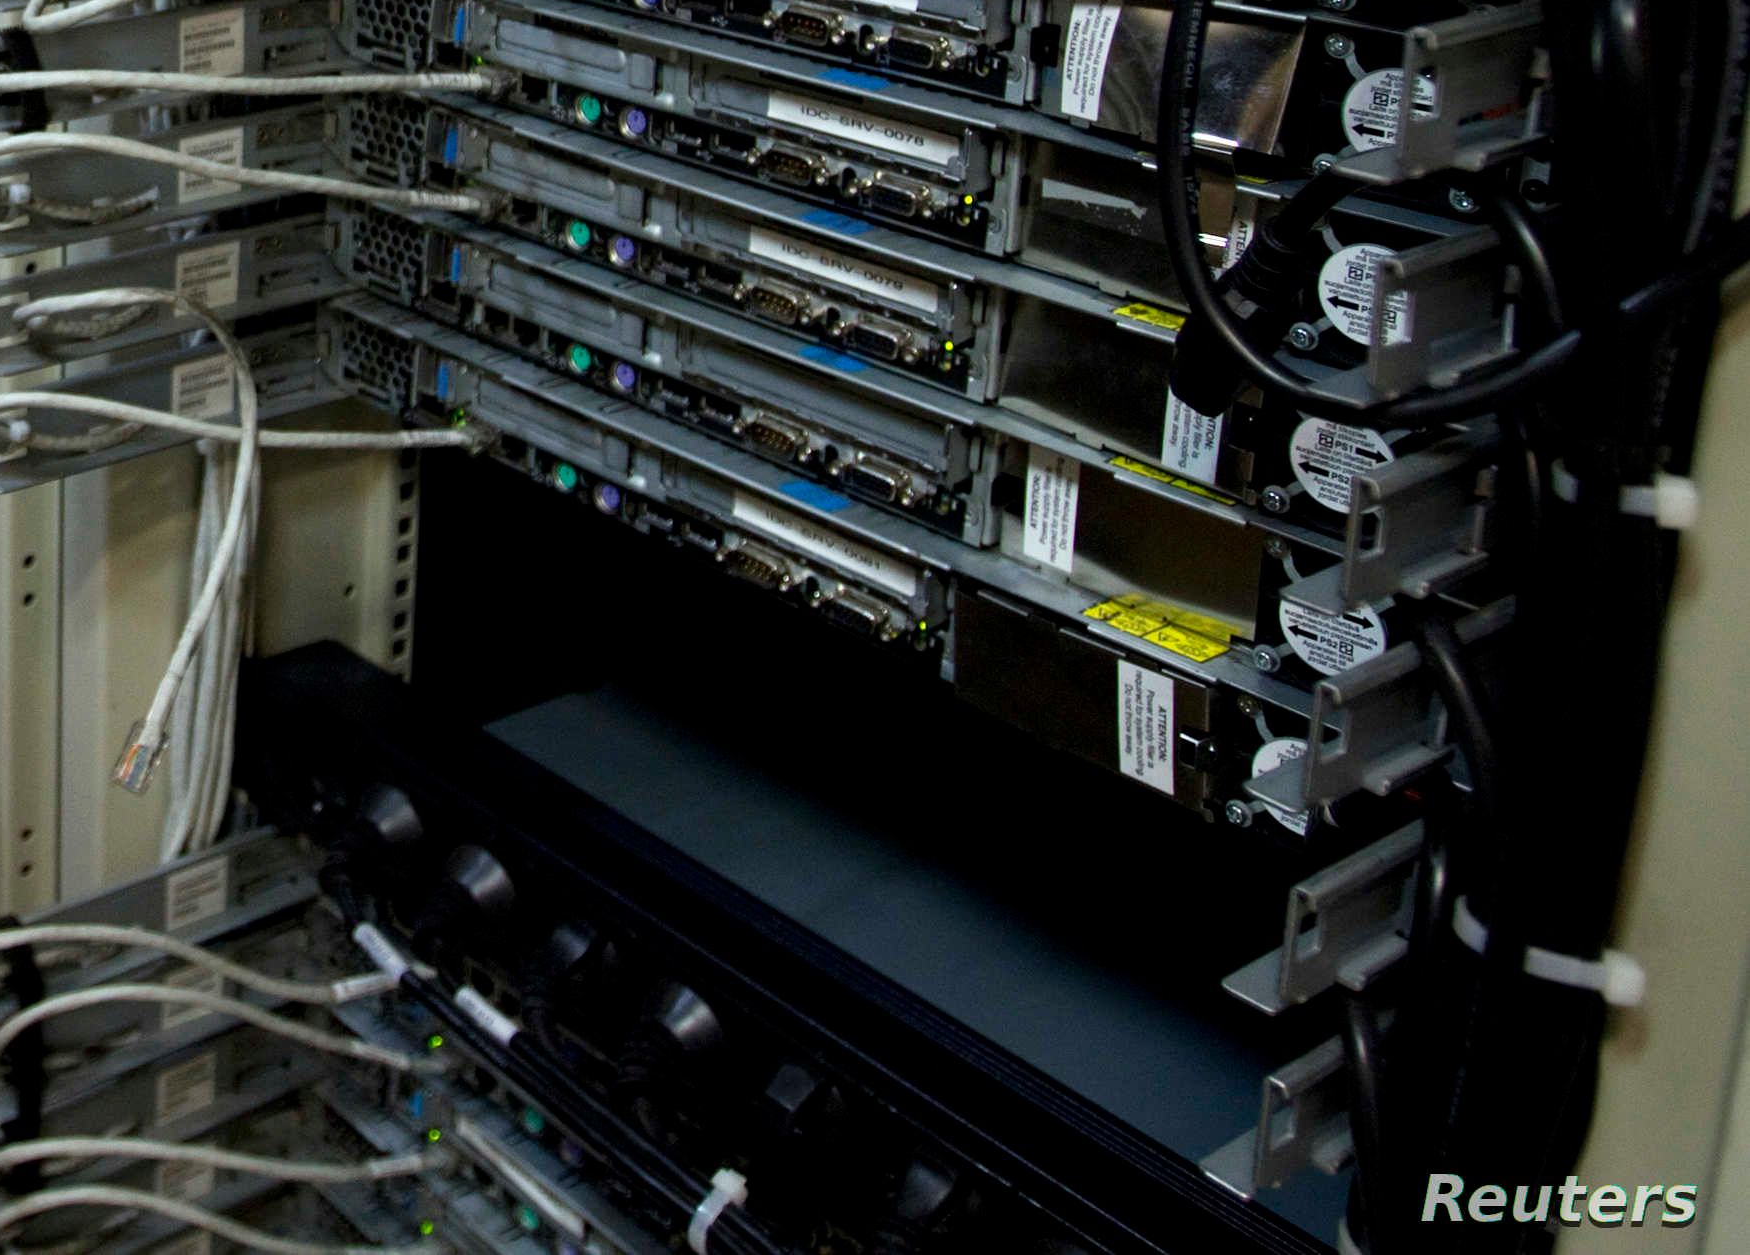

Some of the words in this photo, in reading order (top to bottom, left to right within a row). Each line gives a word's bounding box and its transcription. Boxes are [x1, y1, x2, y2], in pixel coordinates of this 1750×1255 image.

[1066, 22, 1080, 80] ATTENTION:
[1089, 83, 1095, 96] Do
[1334, 440, 1353, 452] PS1
[1330, 471, 1349, 484] PS2
[1029, 475, 1040, 528] ATTENTION:
[1158, 705, 1167, 762] ATTENTION:
